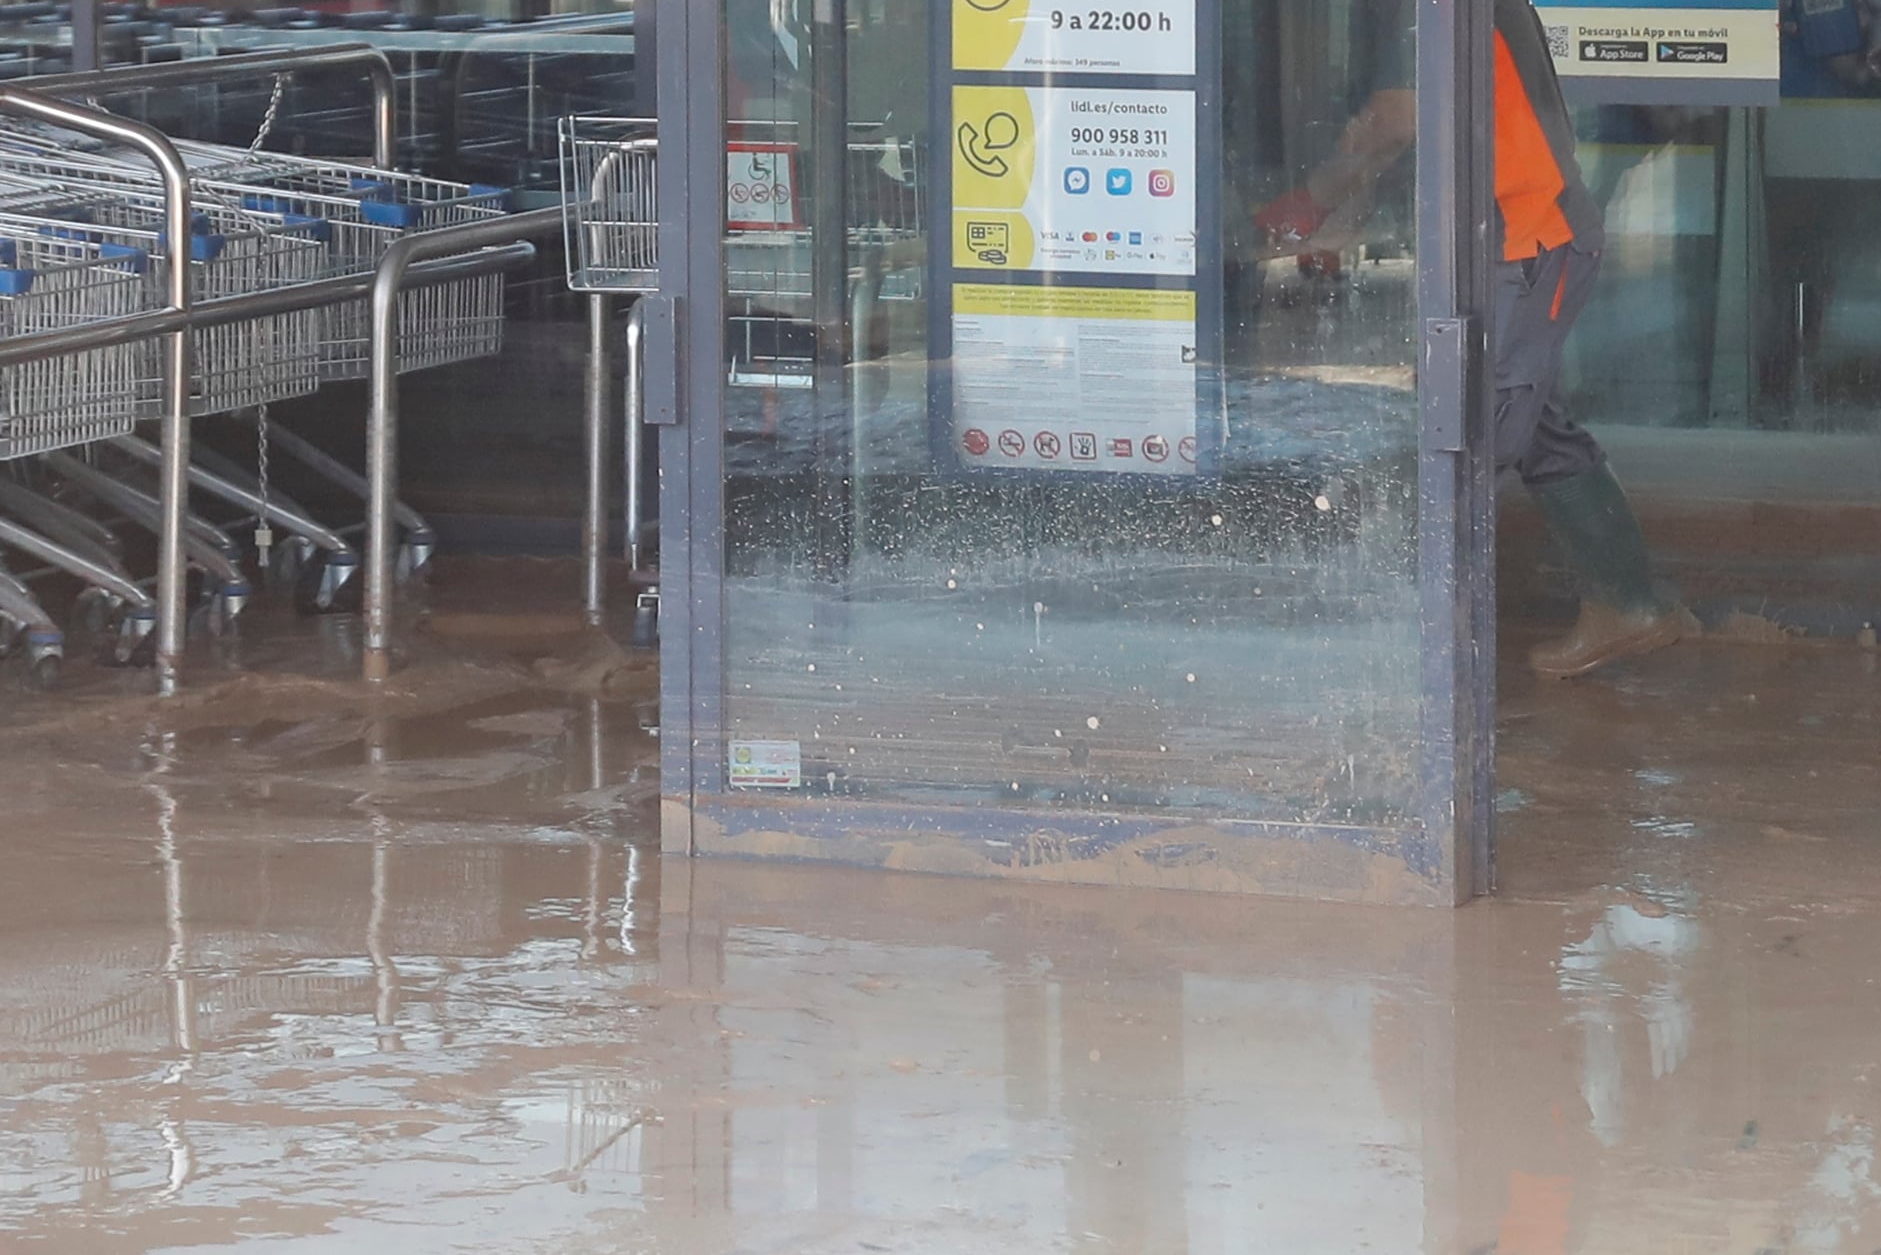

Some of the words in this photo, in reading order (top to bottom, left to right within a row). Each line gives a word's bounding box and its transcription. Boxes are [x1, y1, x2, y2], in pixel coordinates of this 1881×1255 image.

[1050, 11, 1064, 30] 9
[1070, 14, 1082, 30] a
[1088, 11, 1151, 31] 22:00
[1159, 11, 1172, 32] h
[1578, 26, 1628, 39] Descarga
[1631, 27, 1641, 37] la
[1643, 27, 1665, 39] App
[1668, 29, 1681, 37] en
[1684, 29, 1695, 37] tu
[1698, 28, 1728, 38] móvil
[1600, 49, 1619, 60] App
[1621, 49, 1644, 60] Store
[1676, 51, 1705, 62] Google
[1707, 51, 1724, 62] Play
[1070, 100, 1168, 115] lidl.es/contacto
[1071, 128, 1104, 143] 900
[1109, 128, 1139, 144] 958
[1144, 129, 1167, 145] 311
[1071, 147, 1089, 157] Lun.
[1099, 148, 1117, 157] Sáb.
[1119, 148, 1125, 157] 9
[1134, 149, 1159, 158] 20:00
[1162, 150, 1167, 158] h
